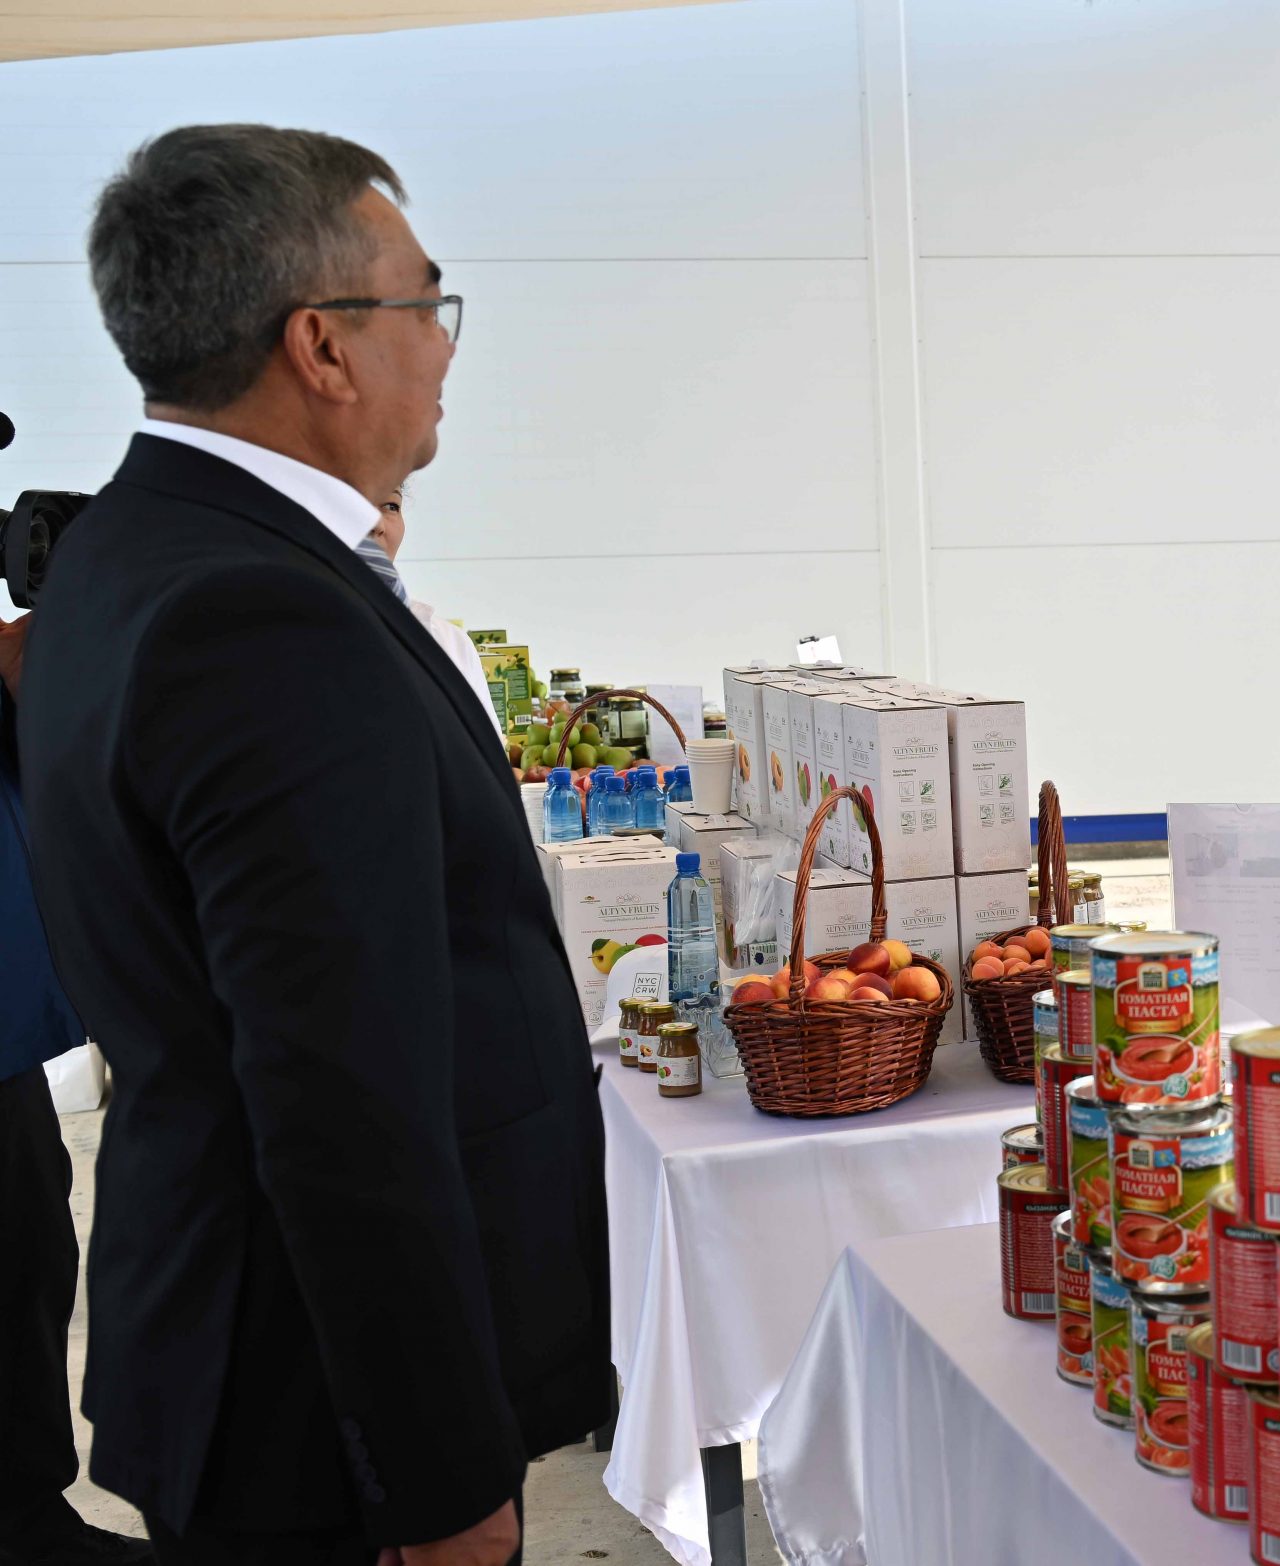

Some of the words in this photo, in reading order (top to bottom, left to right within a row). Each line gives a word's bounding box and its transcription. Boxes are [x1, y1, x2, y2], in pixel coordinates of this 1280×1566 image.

[600, 907, 627, 916] ALTYN
[628, 904, 660, 914] FRUITS
[637, 977, 657, 985] NYC
[1119, 991, 1188, 1004] ТОМАТНАЯ
[1128, 1005, 1179, 1018] ПАСТА
[1116, 1166, 1176, 1184] ТОМАТНАЯ
[1121, 1180, 1166, 1197] ПАСТА
[1150, 1353, 1187, 1368] ТОМАТ
[1158, 1367, 1187, 1381] ПАС
